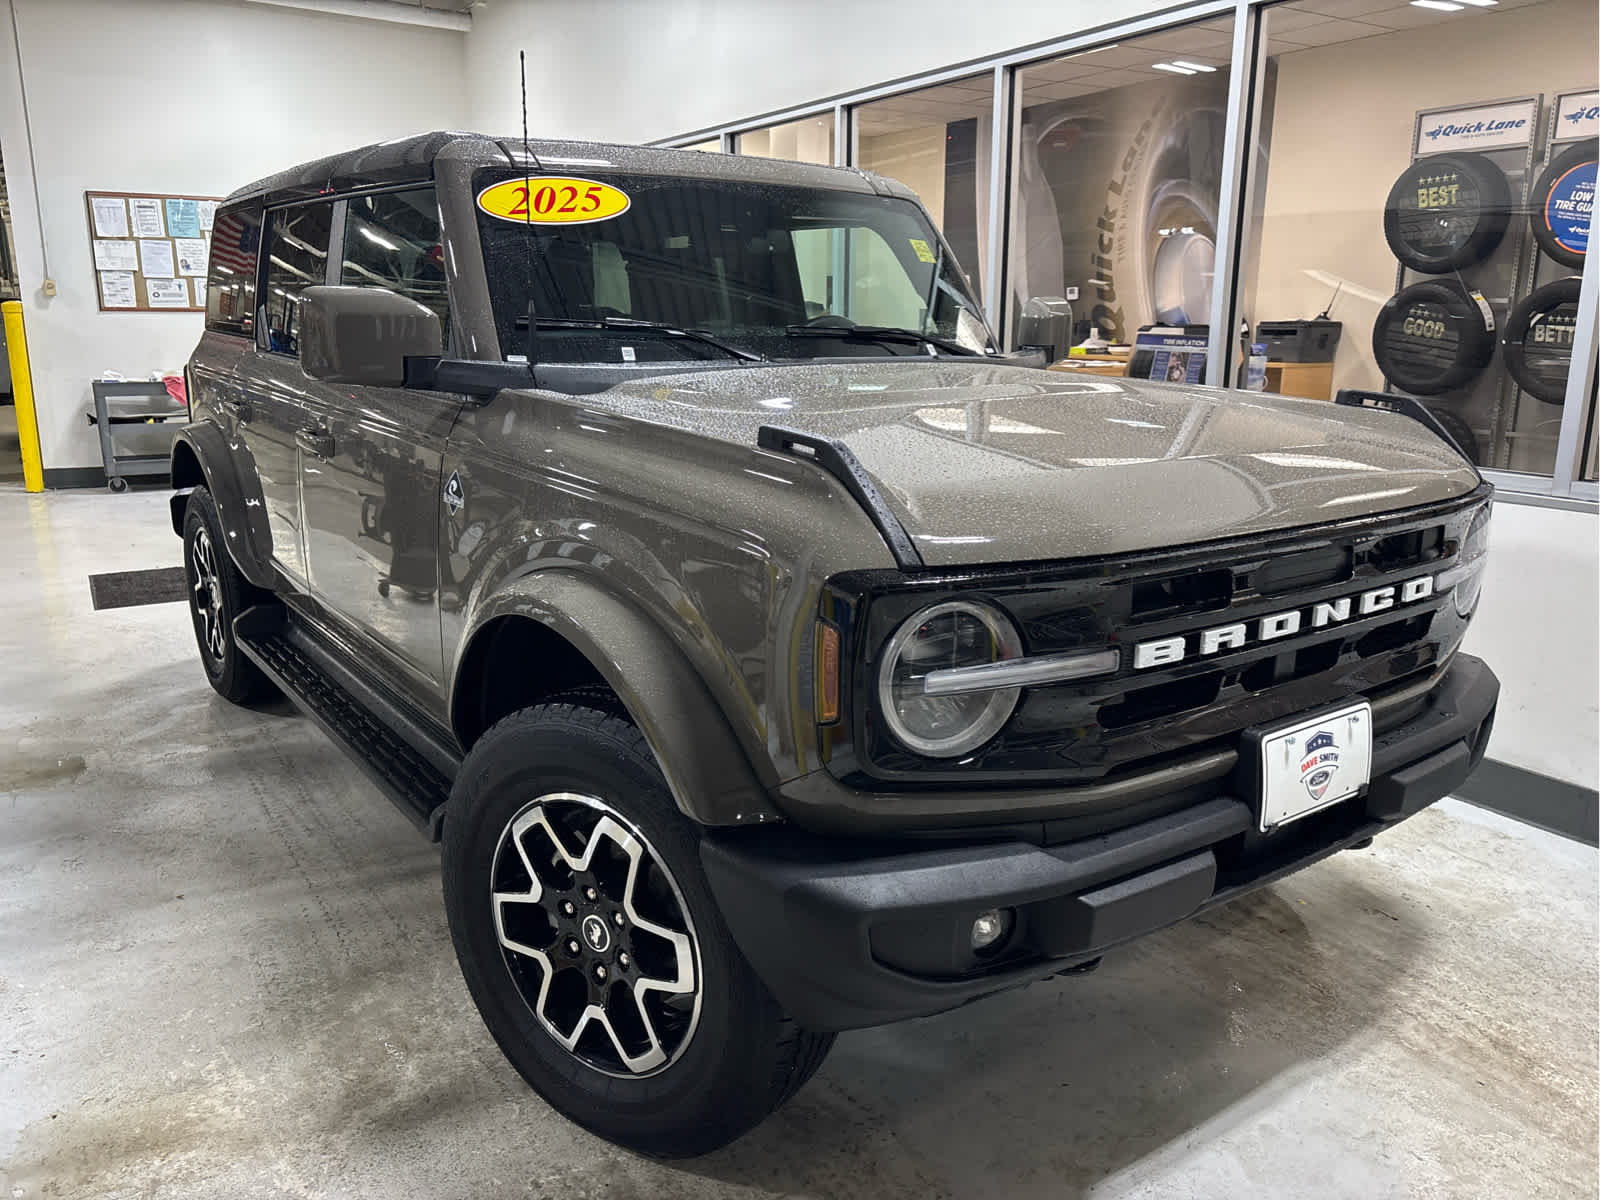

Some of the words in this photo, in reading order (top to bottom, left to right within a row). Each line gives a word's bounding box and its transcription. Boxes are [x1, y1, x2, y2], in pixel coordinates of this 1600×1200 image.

[1442, 121, 1485, 137] Quick
[1486, 119, 1527, 132] Lane
[508, 186, 602, 215] 2025
[1417, 184, 1459, 209] BEST
[1555, 199, 1577, 211] TIRE
[1570, 191, 1593, 202] LOW
[1403, 316, 1446, 340] GOOD
[1535, 324, 1577, 345] BETT
[1133, 575, 1434, 670] BRONCO
[1301, 756, 1318, 773] DAVE
[1319, 753, 1339, 763] SMITH
